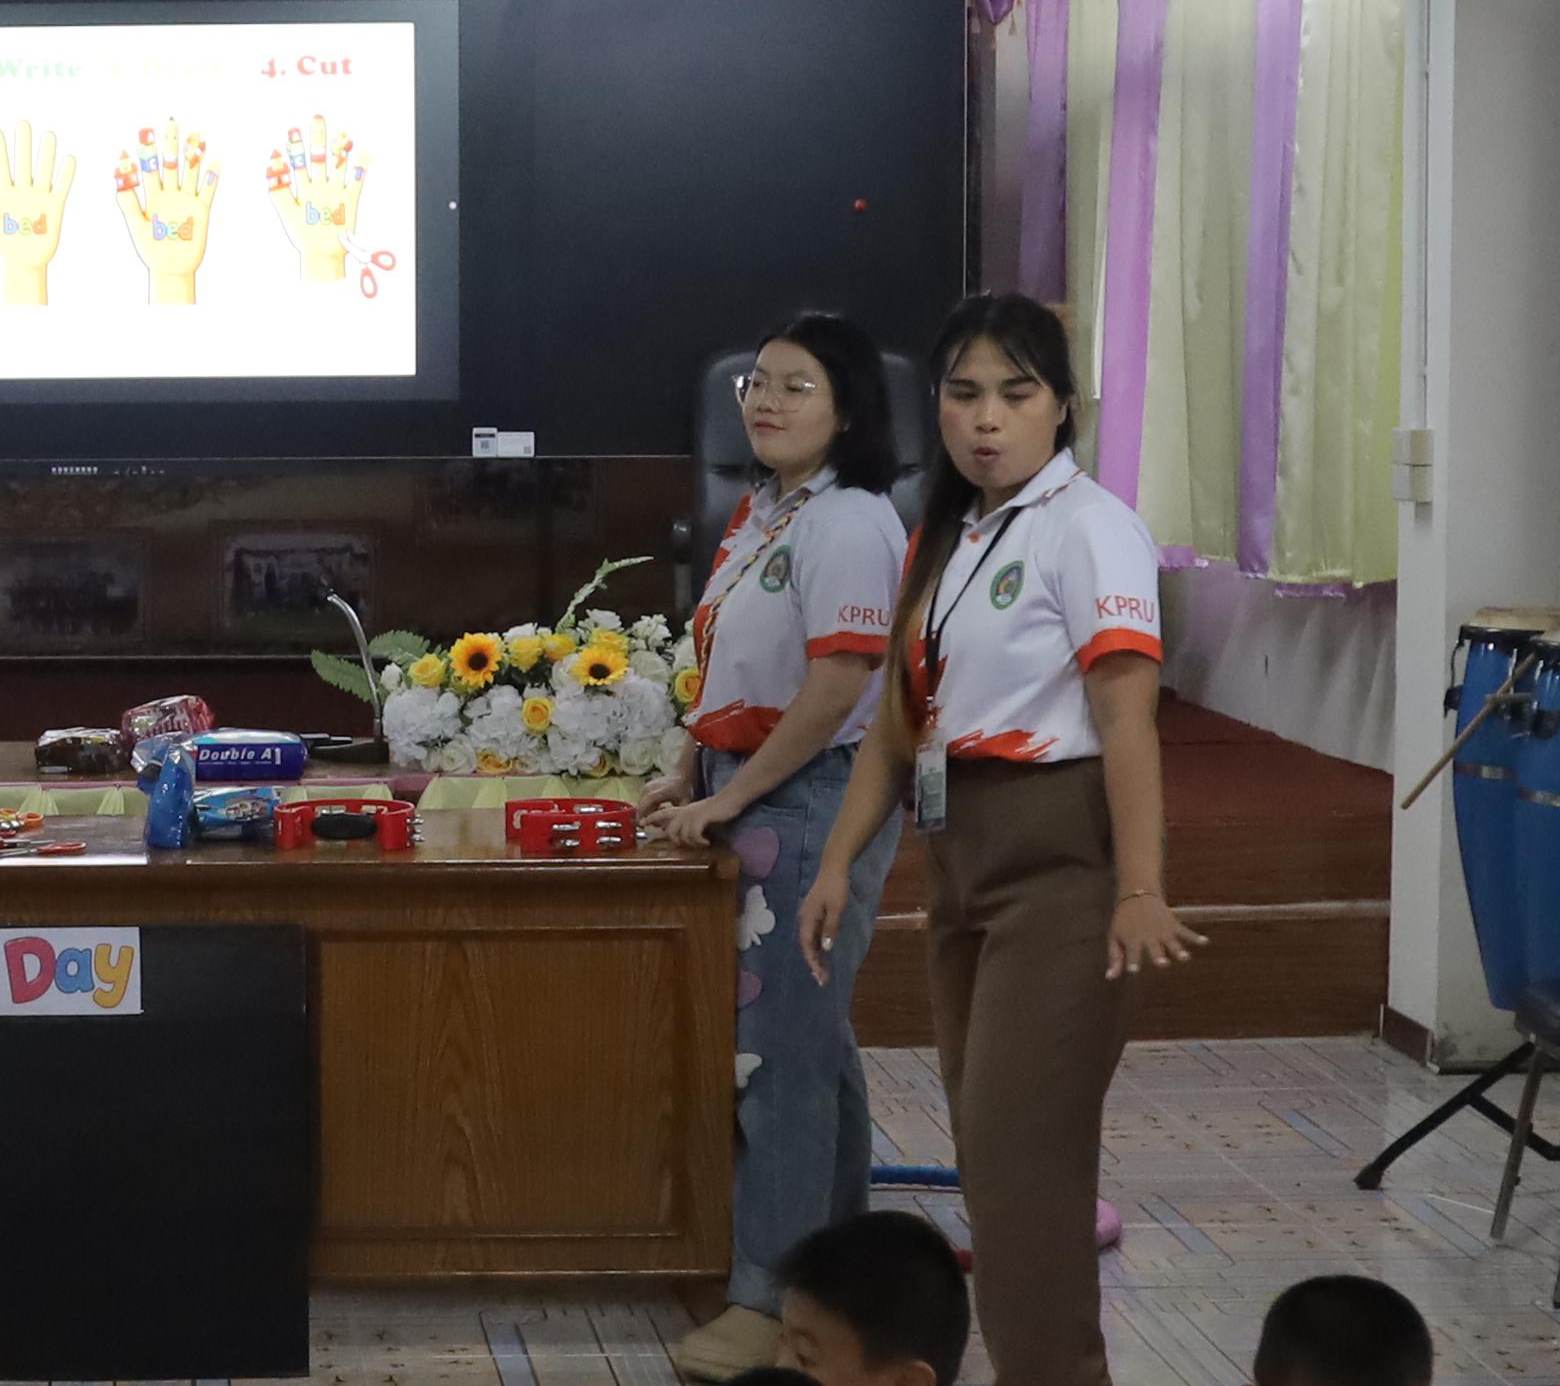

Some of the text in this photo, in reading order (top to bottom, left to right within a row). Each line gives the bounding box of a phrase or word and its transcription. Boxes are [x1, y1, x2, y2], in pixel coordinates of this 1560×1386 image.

[261, 55, 353, 79] 4. Cut
[3, 213, 48, 236] bed
[305, 201, 346, 226] bed
[152, 213, 195, 241] bed
[837, 604, 891, 627] KPRU
[1095, 594, 1155, 623] KPRU
[199, 747, 256, 761] Double
[3, 936, 134, 1008] Day
